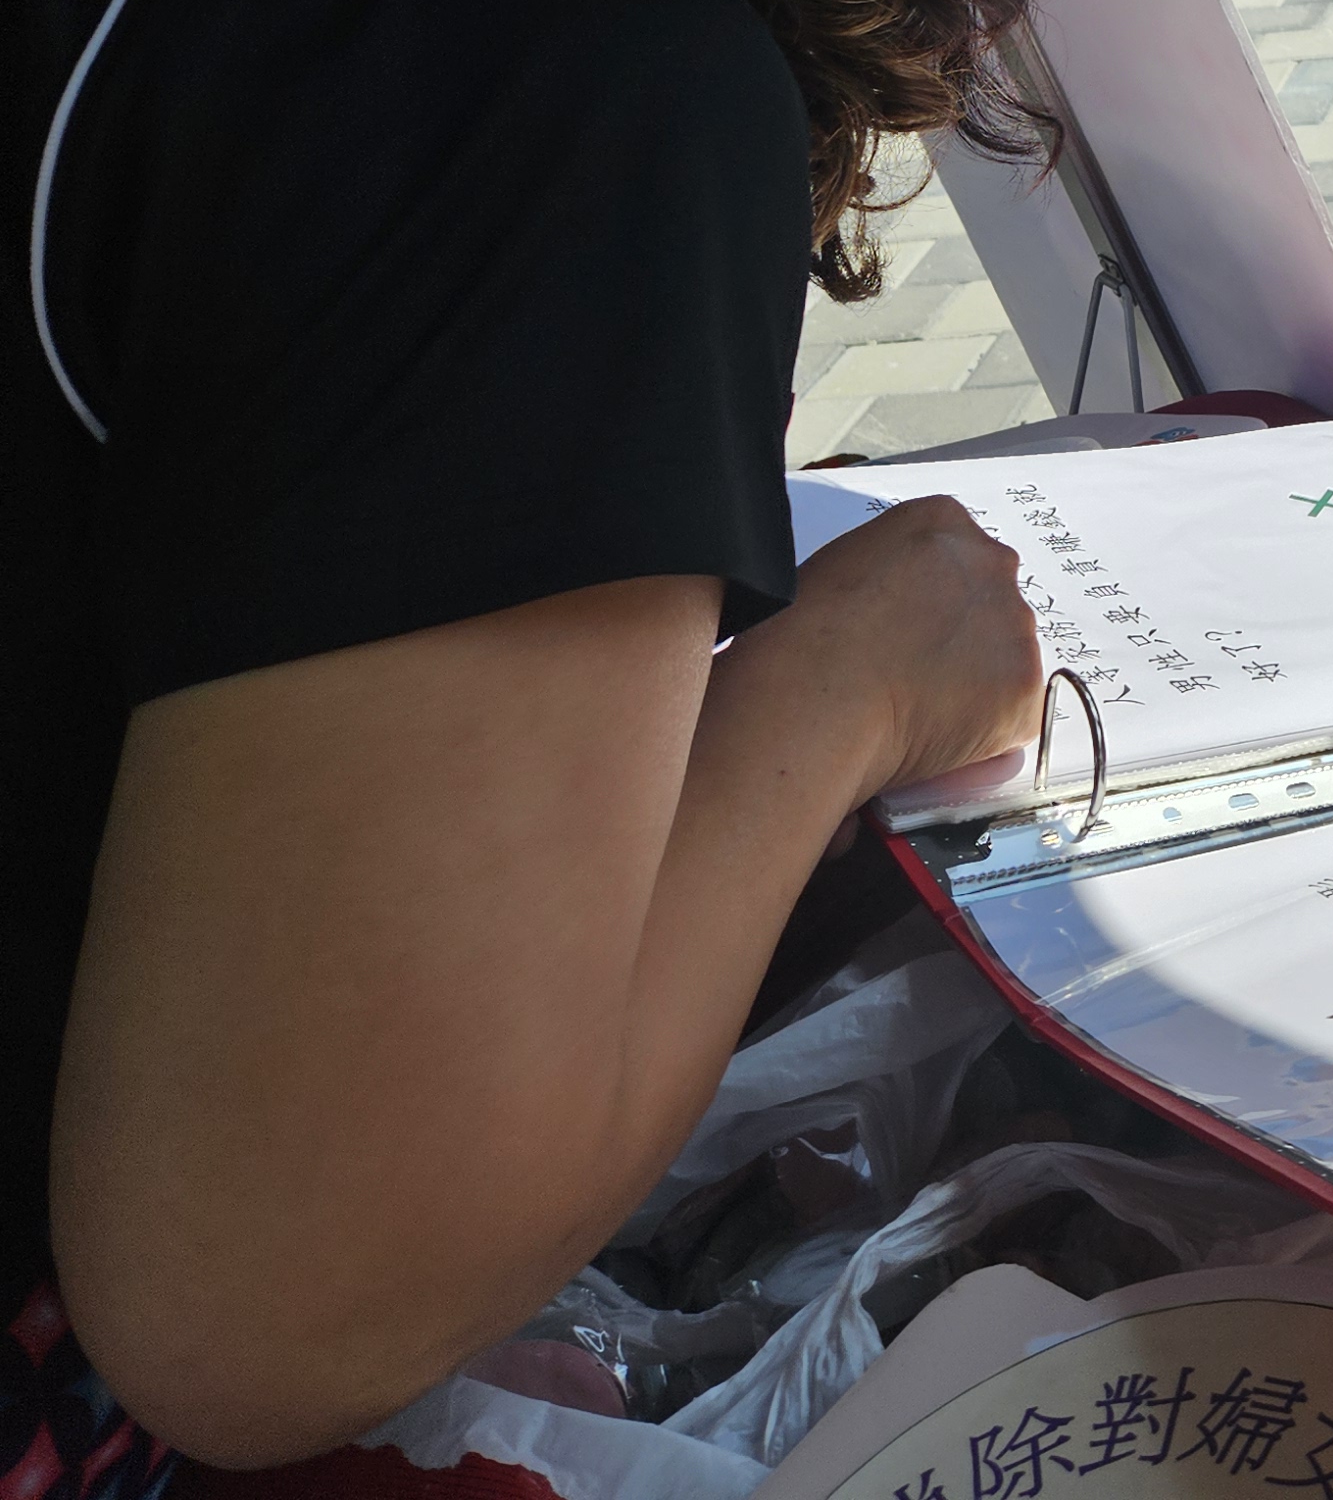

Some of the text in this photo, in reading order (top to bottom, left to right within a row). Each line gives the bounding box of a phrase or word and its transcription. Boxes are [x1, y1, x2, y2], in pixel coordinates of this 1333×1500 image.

[1005, 484, 1221, 694] 男性只要負責賺錢就
